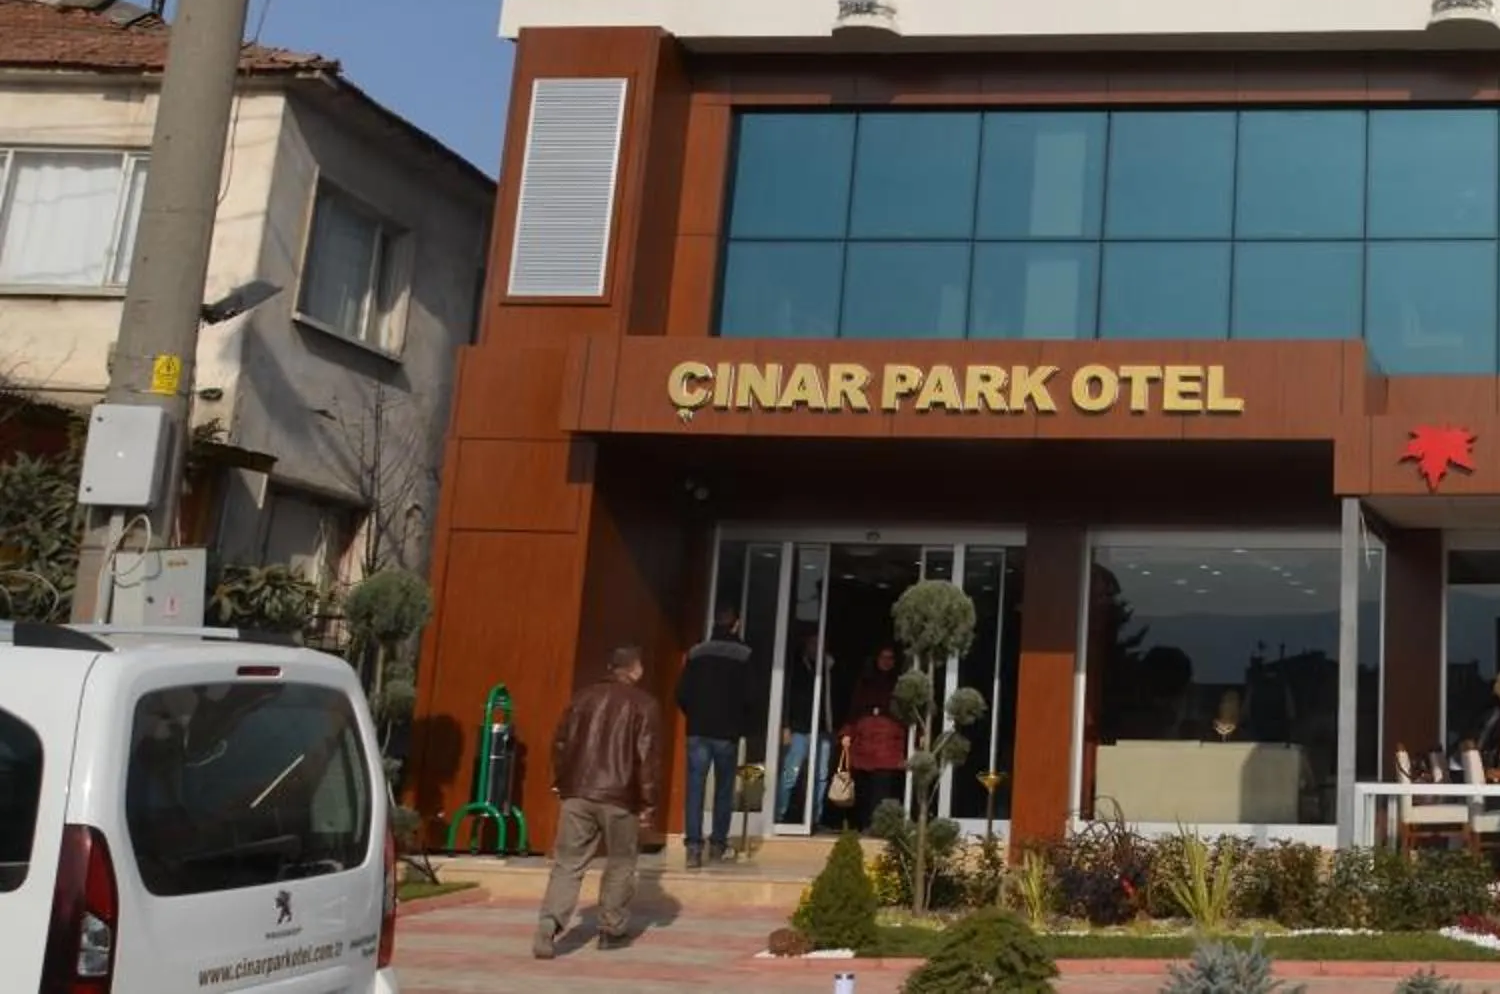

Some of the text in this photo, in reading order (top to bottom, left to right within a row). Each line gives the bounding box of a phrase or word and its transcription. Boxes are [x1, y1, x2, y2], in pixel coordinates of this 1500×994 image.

[667, 361, 1245, 424] ÇINAR PARK OTEL
